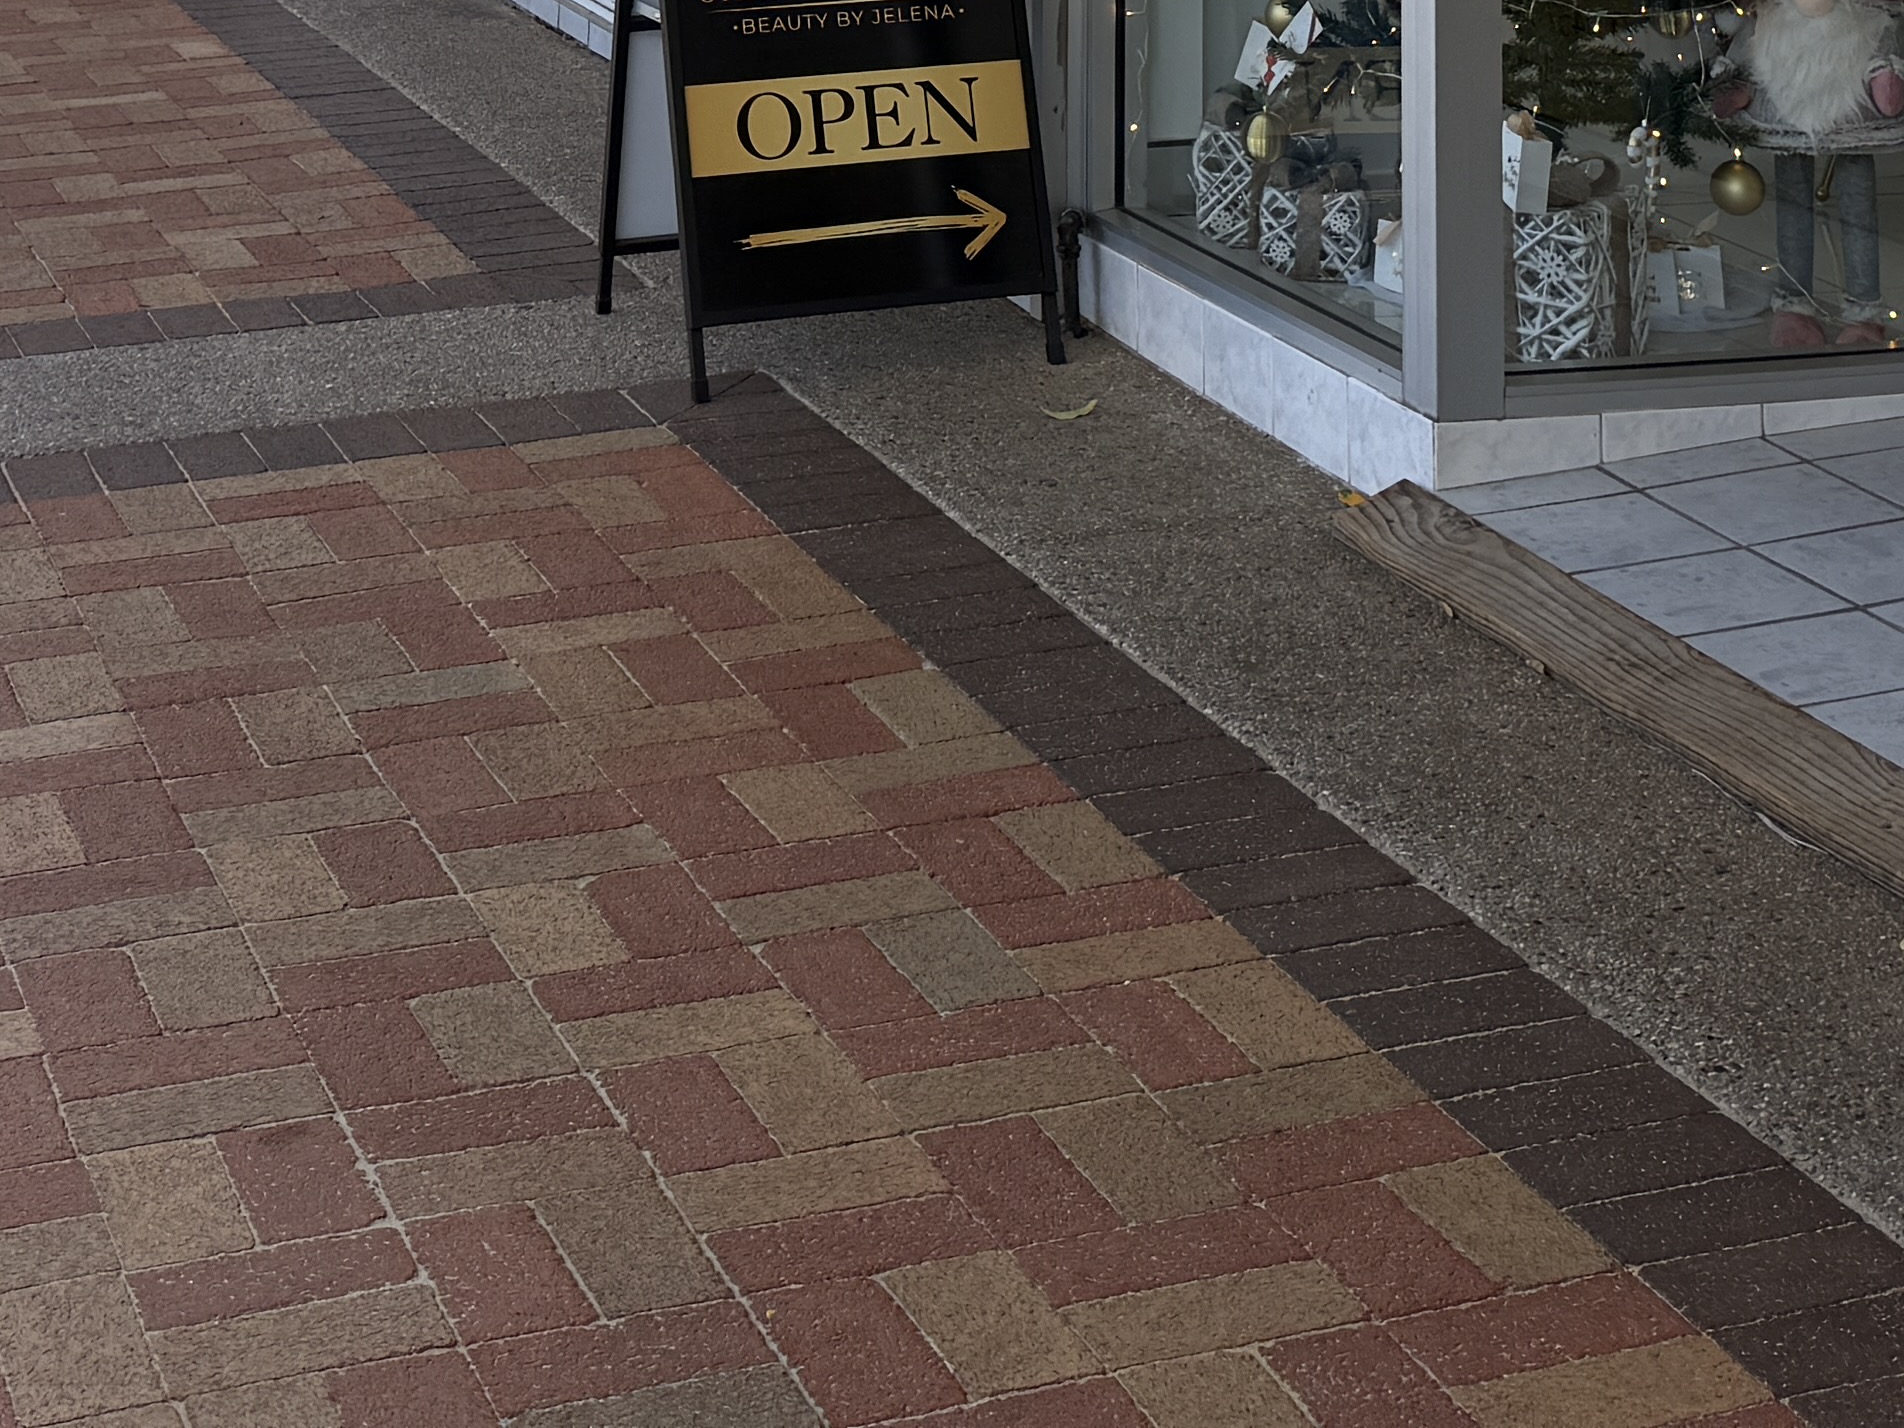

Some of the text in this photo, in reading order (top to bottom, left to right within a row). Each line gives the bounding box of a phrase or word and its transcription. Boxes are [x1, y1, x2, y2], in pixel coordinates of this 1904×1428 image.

[741, 3, 957, 36] BEAUTY BY JELENA
[735, 76, 980, 162] OPEN
